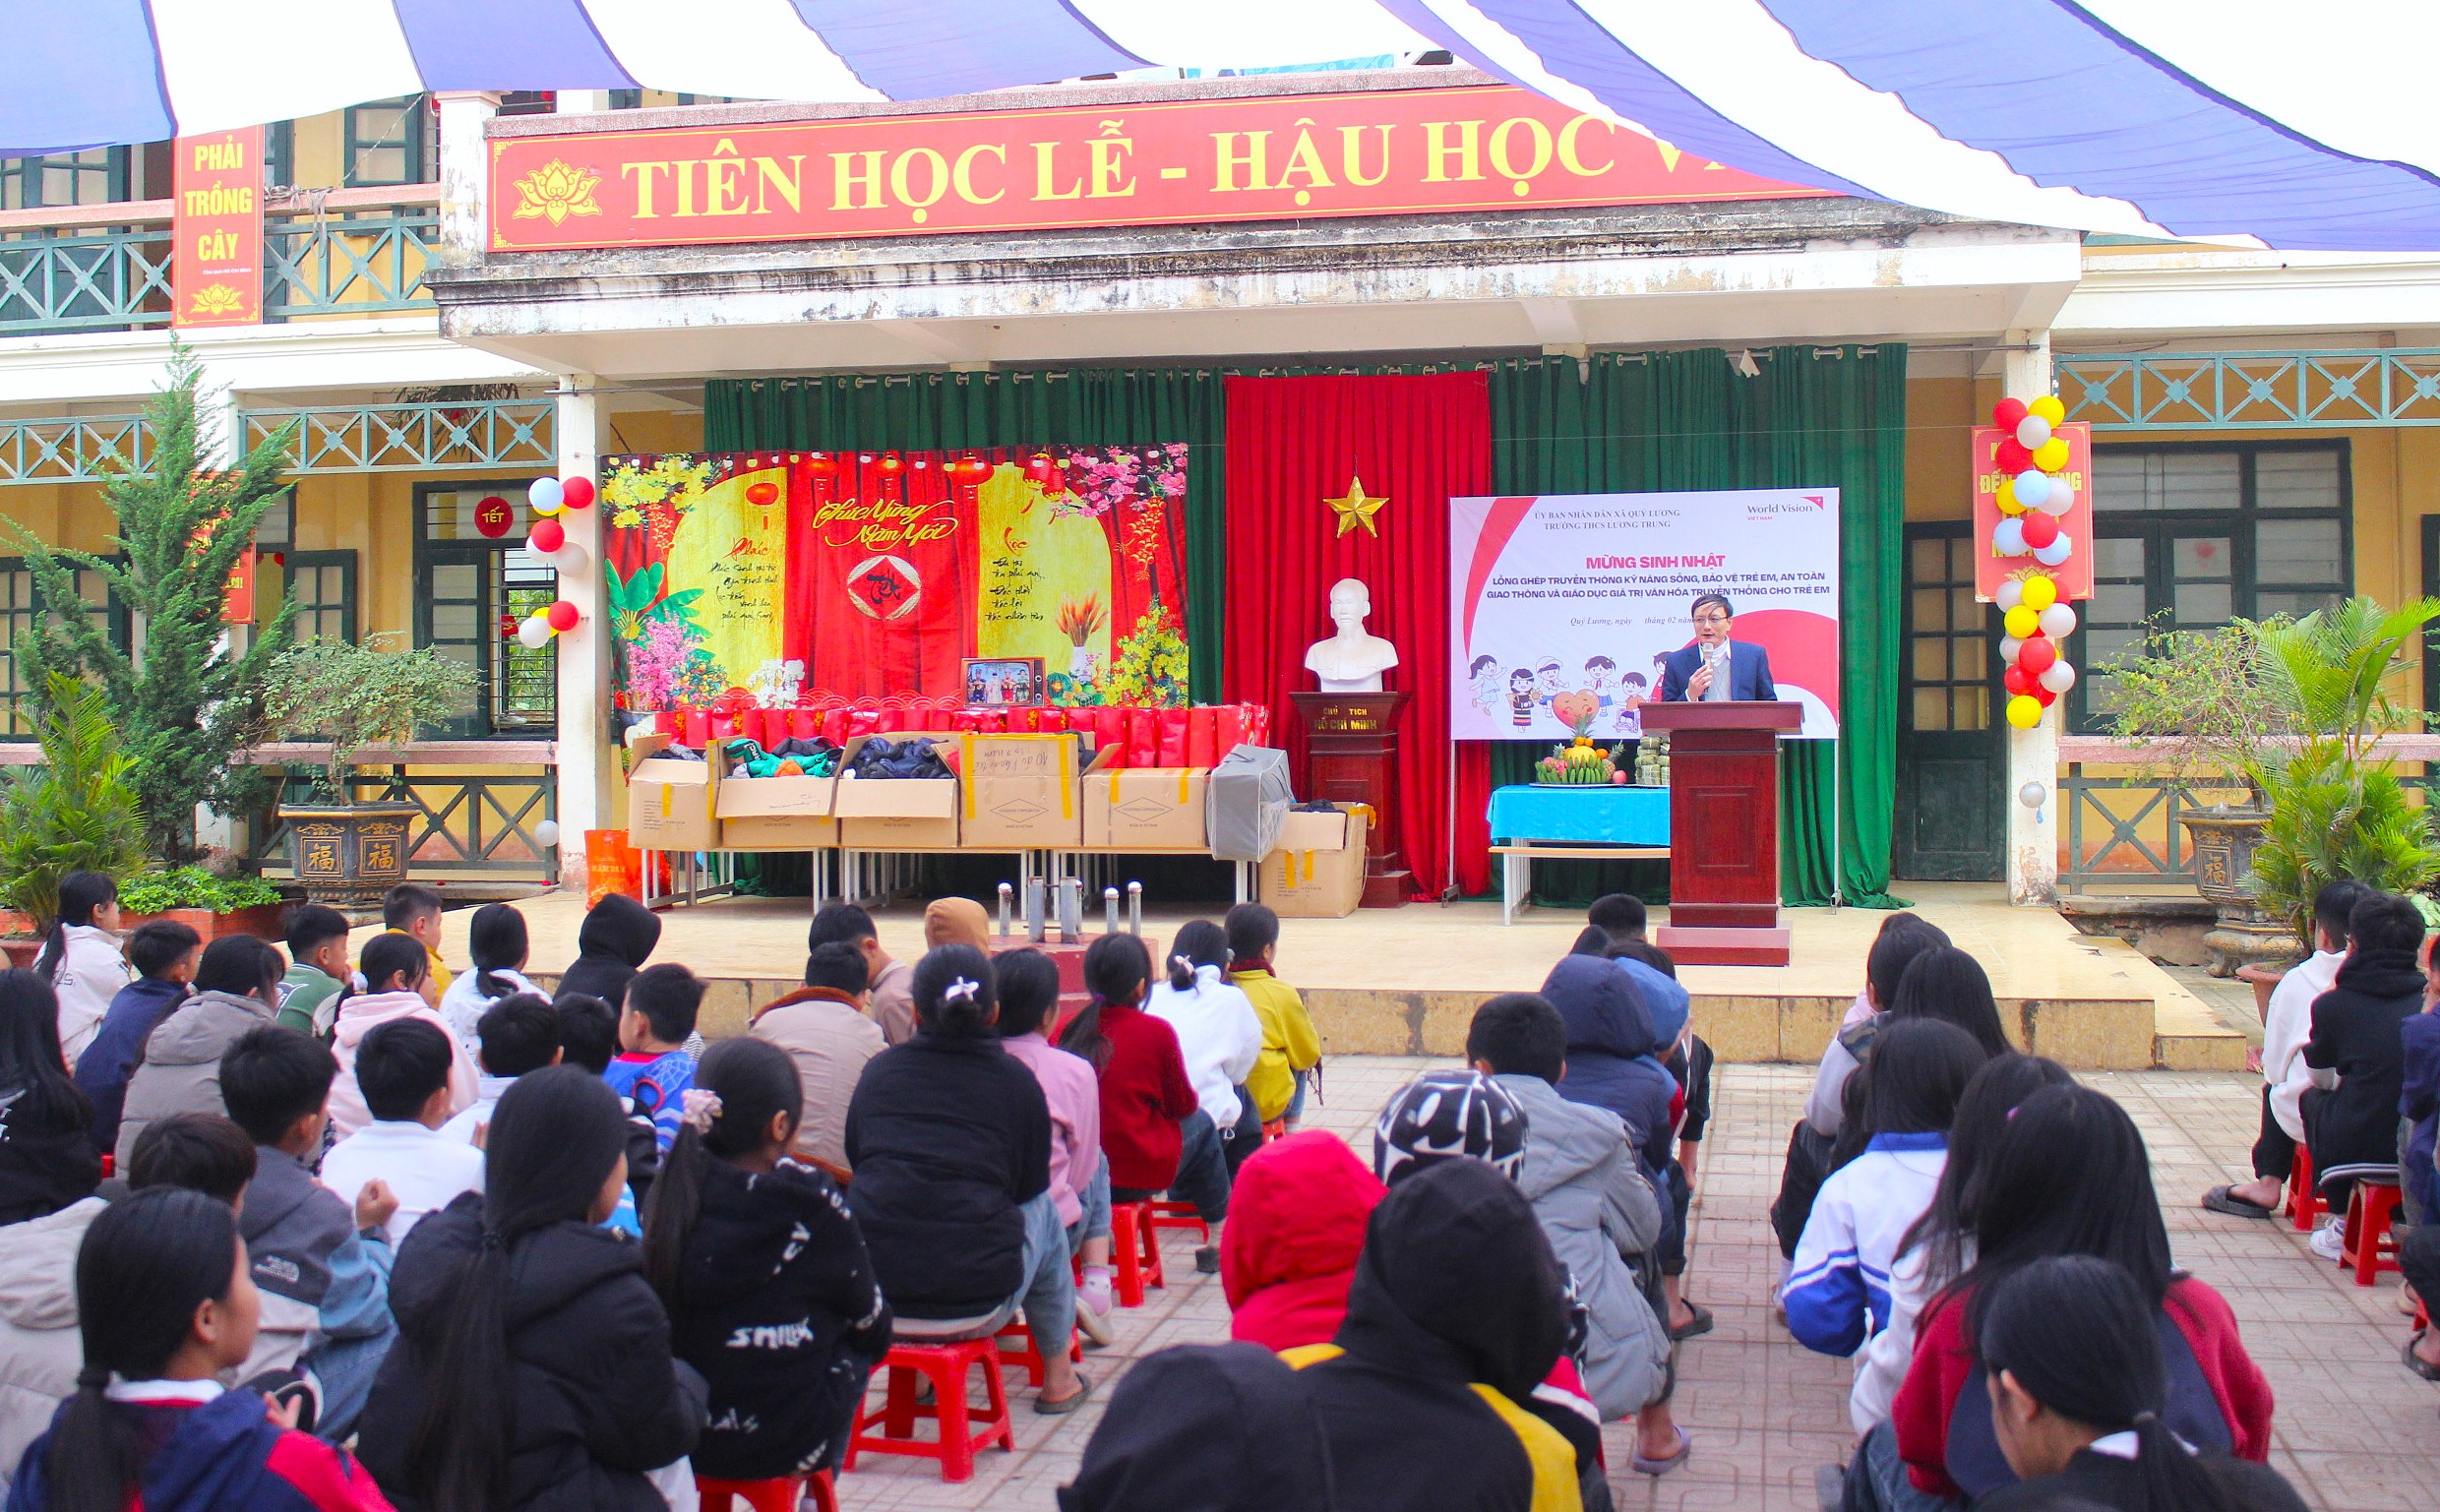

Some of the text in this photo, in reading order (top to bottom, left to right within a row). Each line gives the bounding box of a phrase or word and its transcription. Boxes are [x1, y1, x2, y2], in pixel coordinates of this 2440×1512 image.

[194, 135, 243, 171] PHẢI
[622, 138, 807, 218] TIÊN
[827, 144, 1006, 224] HỌC
[1029, 119, 1136, 202] LỄ
[1209, 117, 1397, 207] HẬU
[1420, 113, 1616, 197] HỌC
[185, 180, 253, 216] TRỒNG
[198, 228, 239, 262] CÂY
[482, 506, 505, 522] TẾT
[813, 499, 868, 528] Chúc
[1568, 509, 1592, 518] NHÂN
[1594, 509, 1612, 518] DÂN
[1615, 509, 1625, 517] XÃ
[1747, 503, 1813, 514] World Vision
[1544, 520, 1580, 529] TRƯỜNG
[832, 523, 901, 546] Năm
[1586, 553, 1726, 570] MỪNG SINH NHẬT
[1520, 575, 1546, 585] GHÉP
[1548, 574, 1587, 584] TRUYỀN
[1624, 574, 1637, 583] KỸ
[1639, 575, 1668, 583] NĂNG
[1670, 573, 1700, 583] SỐNG,
[1702, 573, 1723, 582] BẢO
[1725, 573, 1738, 583] VỆ
[1739, 572, 1758, 581] TRẺ
[1760, 574, 1778, 582] EM,
[1797, 572, 1825, 580] TOÀN
[1487, 590, 1510, 599] GIAO
[1511, 589, 1546, 598] THÔNG
[1548, 588, 1560, 598] VÀ
[1561, 589, 1585, 598] GIÁO
[1587, 589, 1608, 599] DỤC
[1610, 588, 1626, 597] GIÁ
[1628, 589, 1643, 598] TRỊ
[1645, 588, 1666, 597] VĂN
[1667, 586, 1689, 596] HÓA
[1690, 584, 1731, 596] TRUYỀN
[1732, 584, 1767, 595] THỐNG
[1793, 584, 1812, 594] TRẺ
[1645, 616, 1666, 625] tháng
[1350, 719, 1377, 730] MINH
[308, 843, 336, 872] 福
[367, 843, 395, 871] 福
